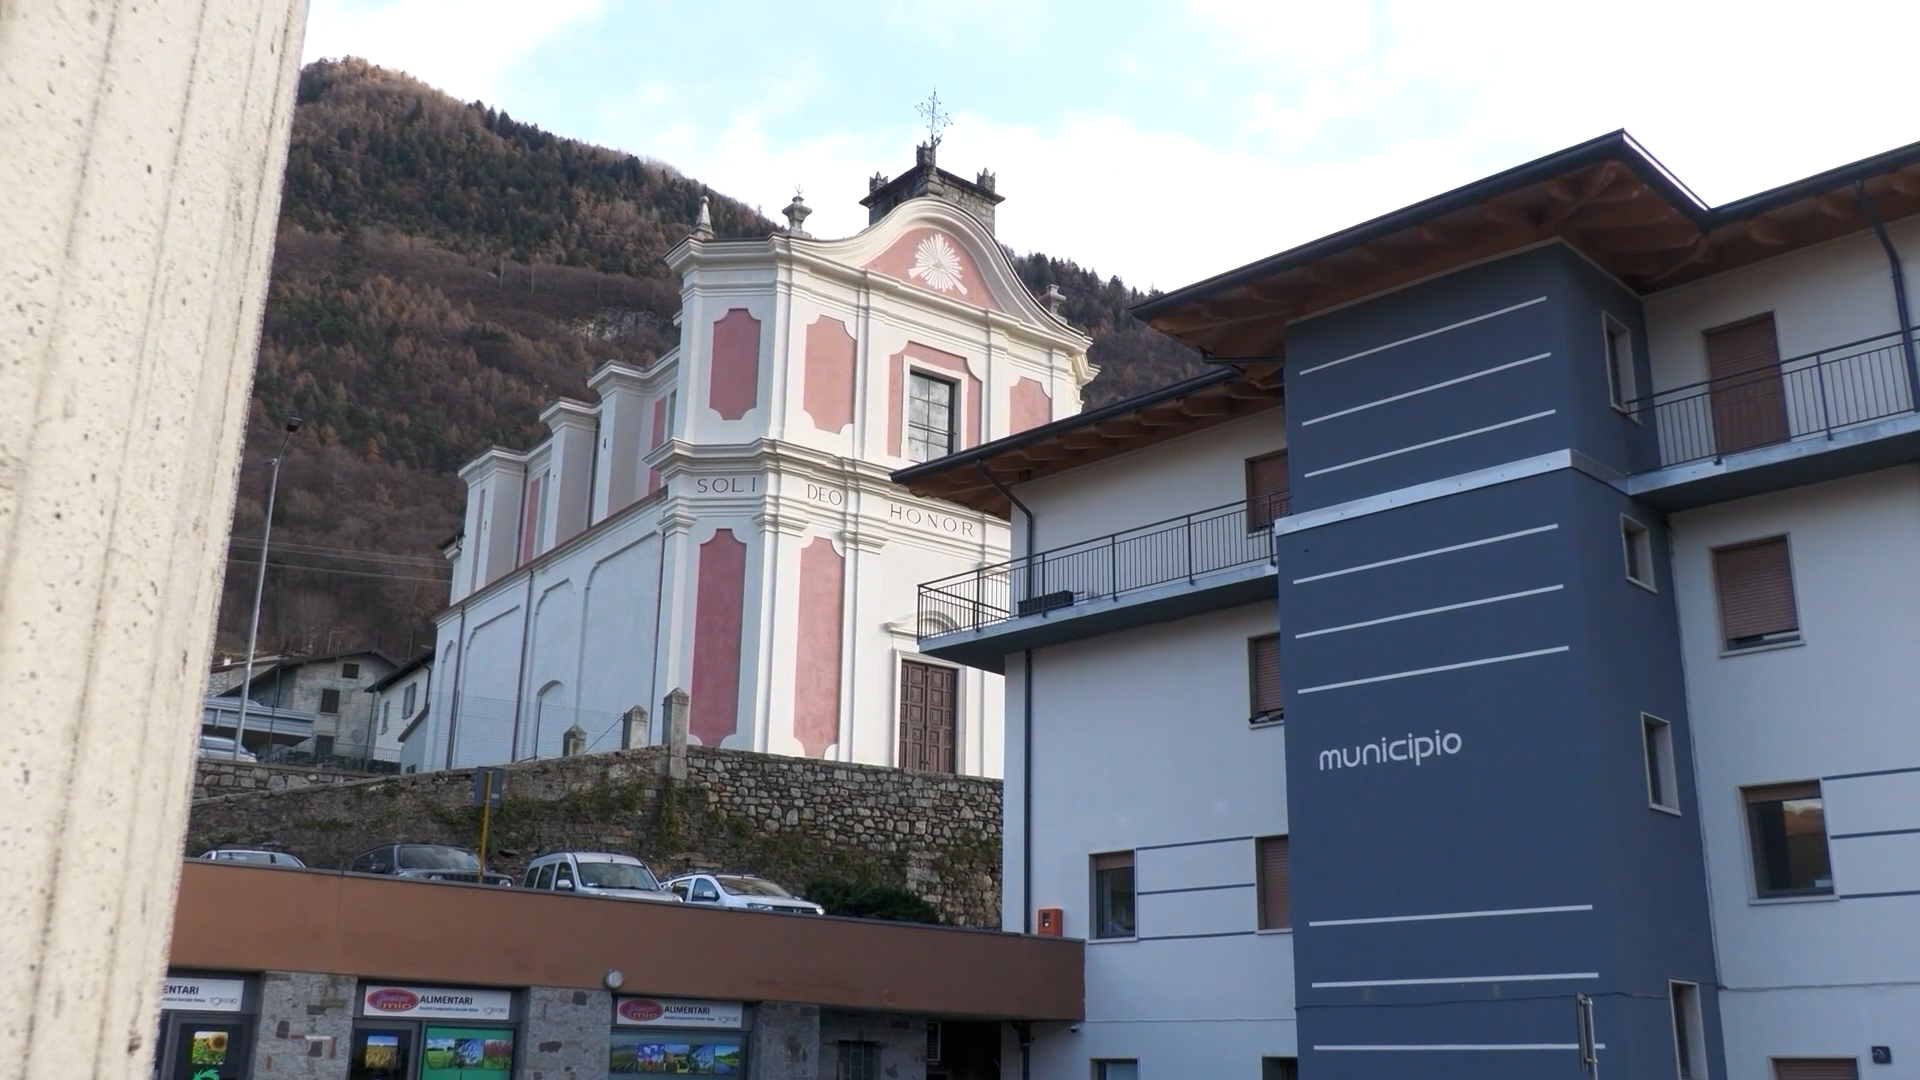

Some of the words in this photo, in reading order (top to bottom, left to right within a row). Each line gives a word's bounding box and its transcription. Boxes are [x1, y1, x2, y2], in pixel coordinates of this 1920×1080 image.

[696, 476, 756, 494] SOLI
[807, 483, 843, 506] DEO
[889, 503, 974, 537] HONOR
[1319, 729, 1462, 771] municipio
[163, 984, 200, 995] ENTARI
[382, 1001, 412, 1009] mio
[419, 995, 473, 1006] ALIMENTARI
[632, 1011, 658, 1019] mio
[664, 1005, 711, 1015] ALIMENTARI
